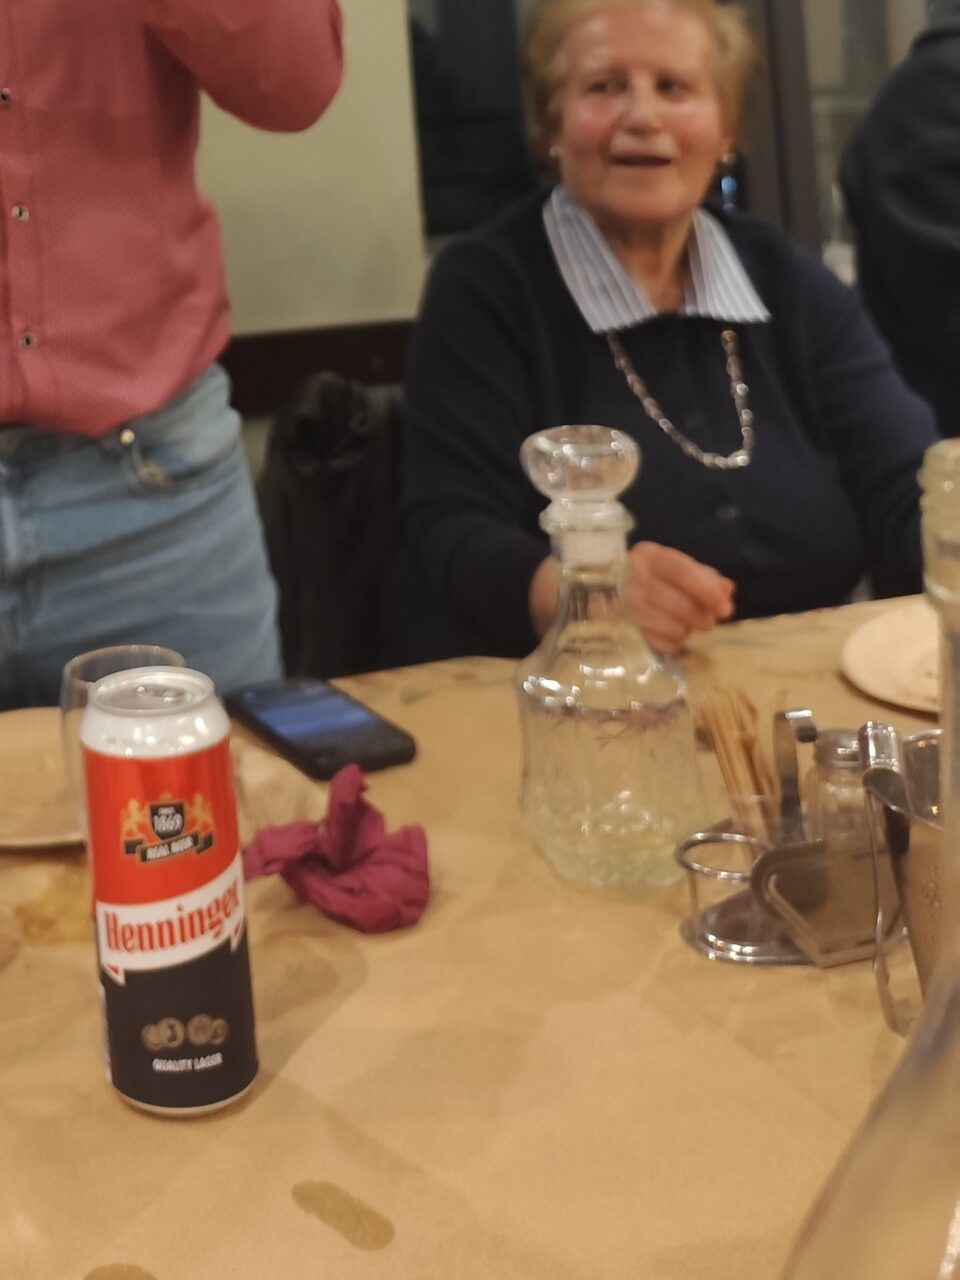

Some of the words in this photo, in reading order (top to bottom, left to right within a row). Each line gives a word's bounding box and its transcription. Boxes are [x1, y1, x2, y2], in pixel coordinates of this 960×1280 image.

[104, 879, 239, 952] Henninger
[152, 1058, 193, 1072] QUALITY
[193, 1052, 223, 1070] LAGER
